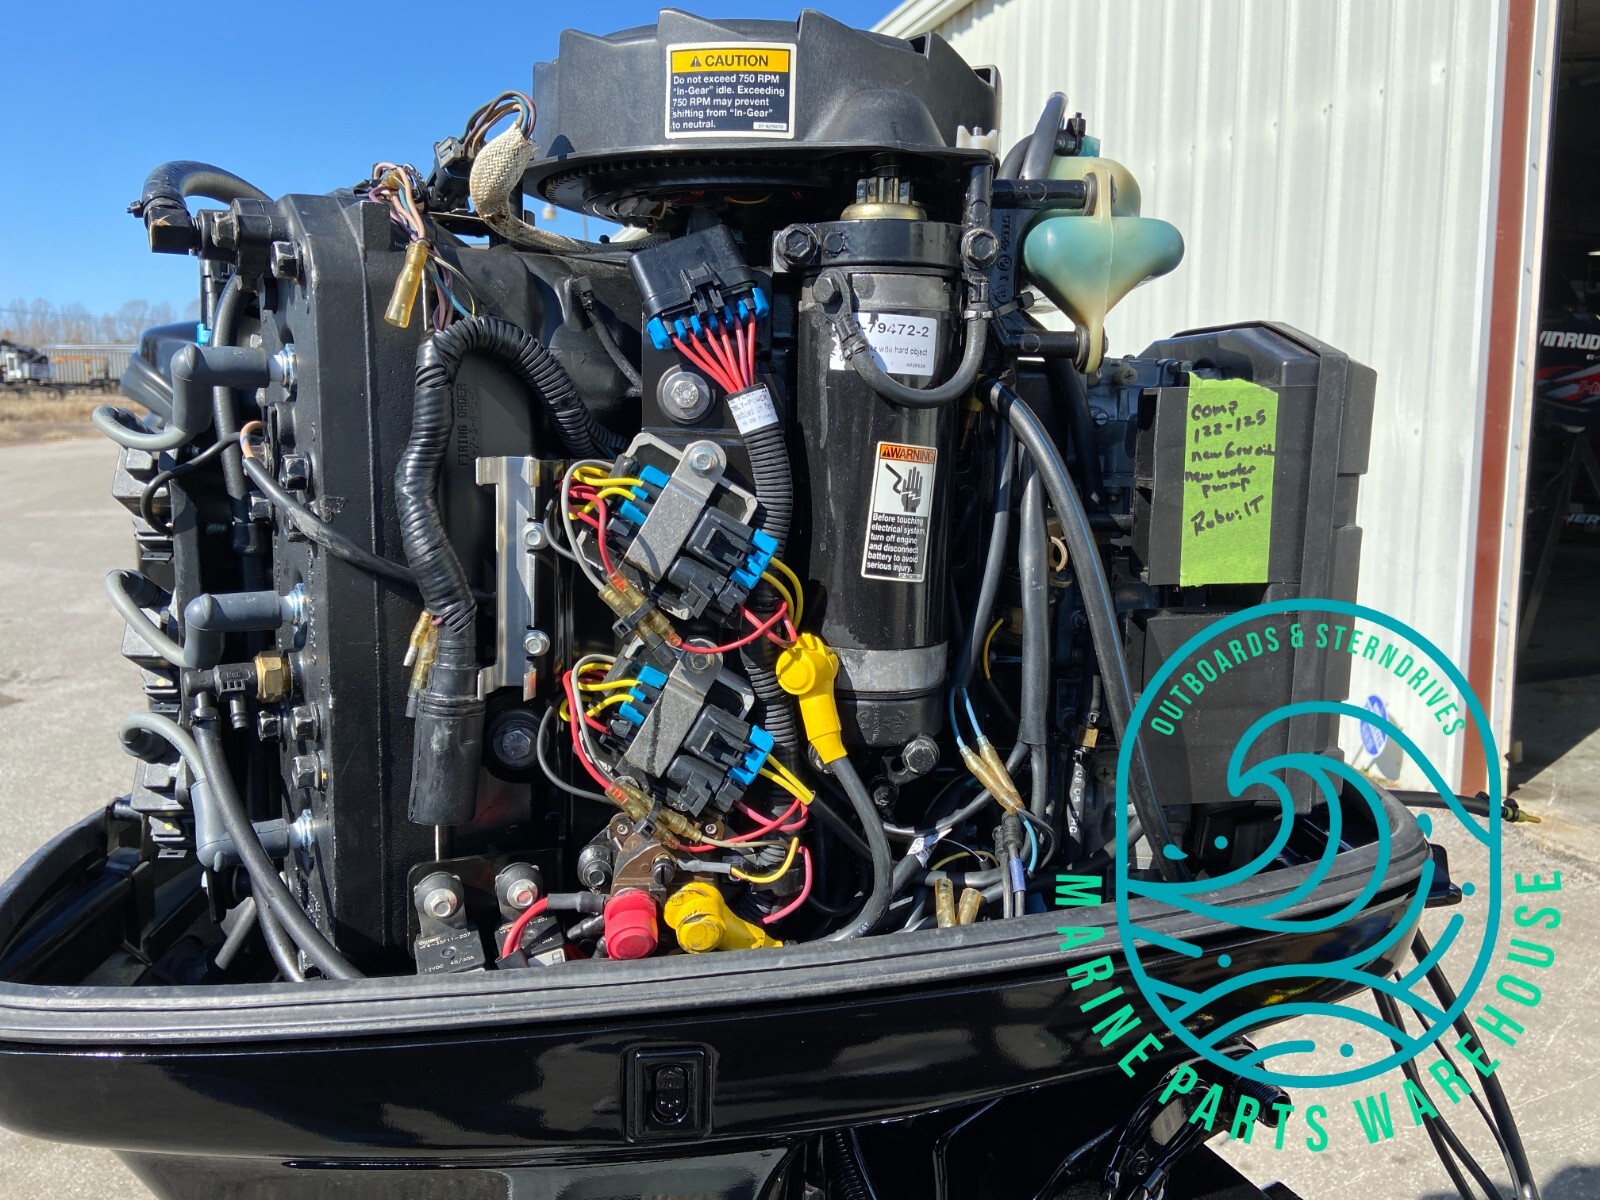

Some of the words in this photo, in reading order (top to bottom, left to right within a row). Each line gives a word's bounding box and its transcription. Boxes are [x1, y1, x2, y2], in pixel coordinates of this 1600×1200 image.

[705, 54, 769, 67] CAUTION
[673, 76, 685, 85] Do
[687, 75, 702, 83] not
[703, 74, 736, 83] exceed
[739, 74, 755, 83] 750
[757, 74, 780, 83] RPM
[716, 86, 735, 94] idle.
[737, 86, 785, 97] Exceeding
[673, 98, 688, 107] 750
[689, 97, 711, 106] RPM
[713, 98, 732, 107] may
[735, 98, 769, 107] prevent
[672, 108, 704, 118] shifting
[706, 108, 727, 117] from
[672, 121, 681, 129] to
[682, 120, 716, 128] neutral.
[894, 347, 909, 355] hard
[910, 348, 928, 357] object
[457, 383, 468, 419] ORDER
[458, 424, 469, 466] FIRING
[891, 447, 934, 461] WARNING
[873, 513, 896, 523] Before
[897, 516, 924, 527] touching
[871, 523, 903, 533] electrical
[870, 533, 885, 541] turn
[886, 534, 896, 542] off
[896, 536, 918, 545] engine
[869, 542, 882, 551] and
[883, 543, 919, 554] disconnect
[867, 551, 892, 563] battery
[893, 553, 901, 561] to
[902, 555, 919, 563] avoid
[866, 561, 892, 570] serious
[893, 562, 913, 573] injury.
[424, 963, 445, 973] 12VDC
